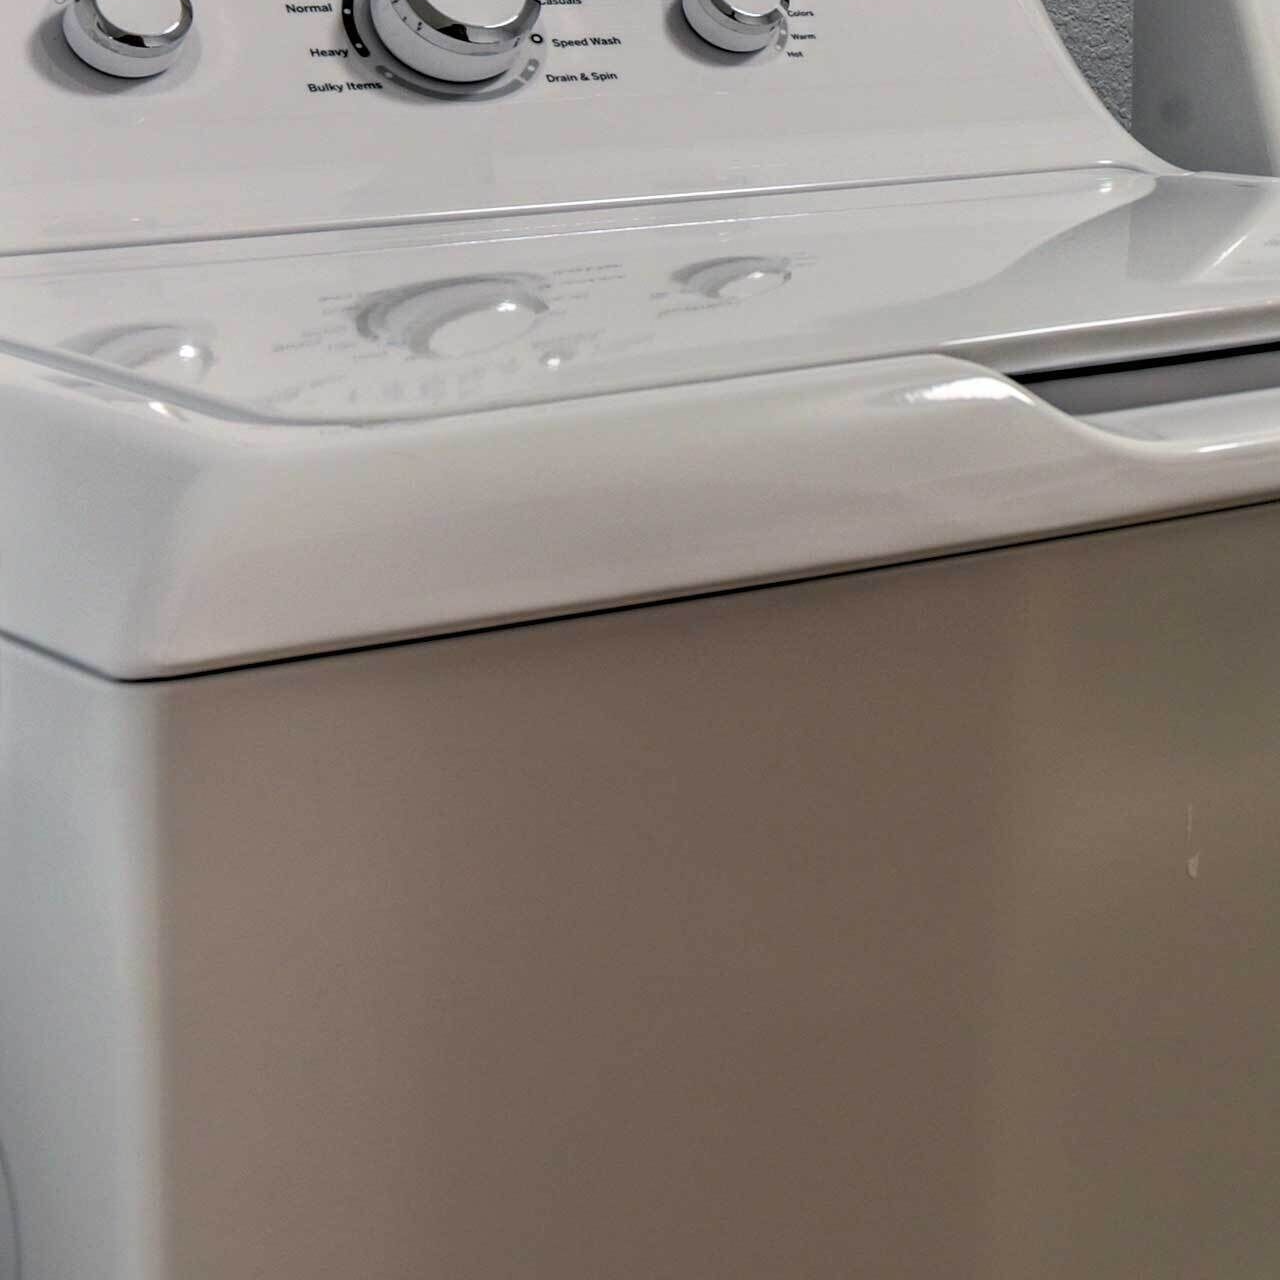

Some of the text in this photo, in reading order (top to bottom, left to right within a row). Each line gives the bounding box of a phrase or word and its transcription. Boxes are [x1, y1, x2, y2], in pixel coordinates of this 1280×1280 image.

[286, 3, 333, 14] Normal
[551, 36, 621, 48] Speed Wash
[310, 48, 349, 58] Heavy
[546, 72, 618, 83] Drain & Spin
[307, 81, 383, 93] Bulky Items
